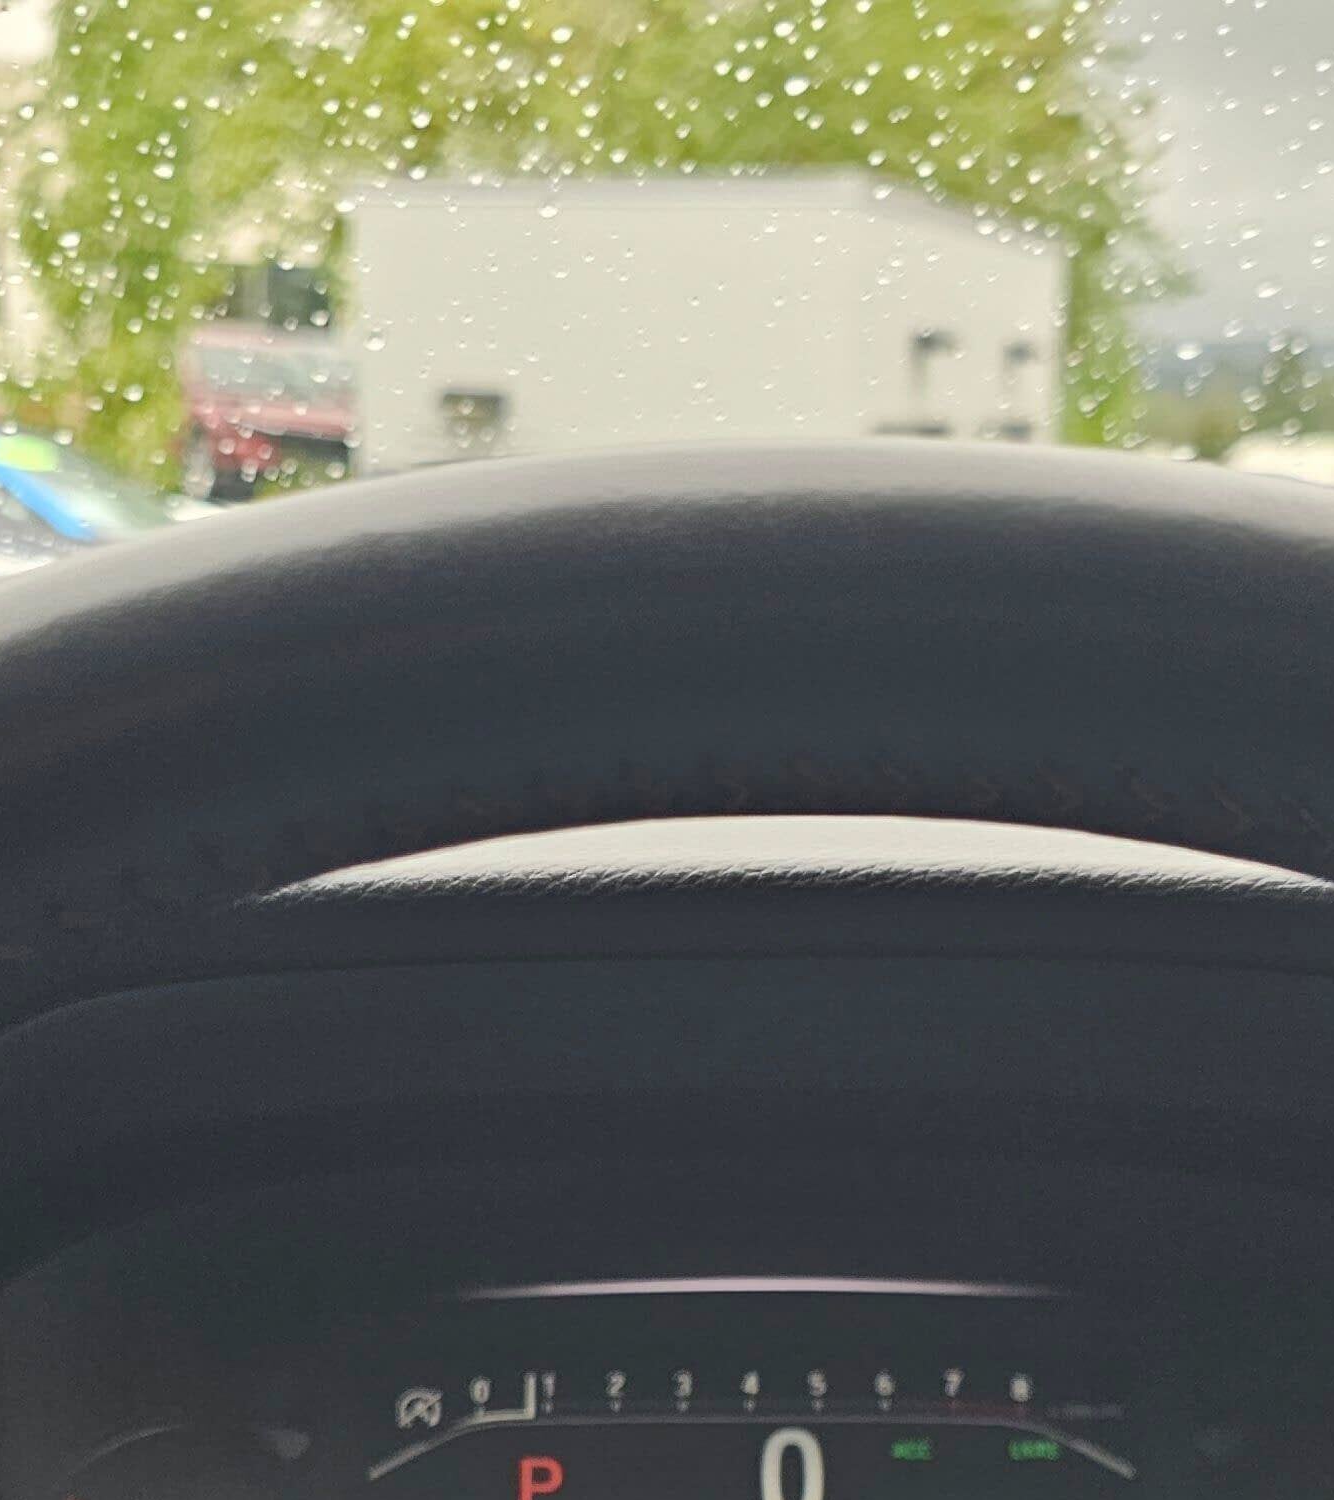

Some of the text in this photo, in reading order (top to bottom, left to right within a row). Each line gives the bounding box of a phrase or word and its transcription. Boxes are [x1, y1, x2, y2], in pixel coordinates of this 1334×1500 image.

[470, 1367, 1033, 1404] 0 1 2 3 4 5 6 7 8
